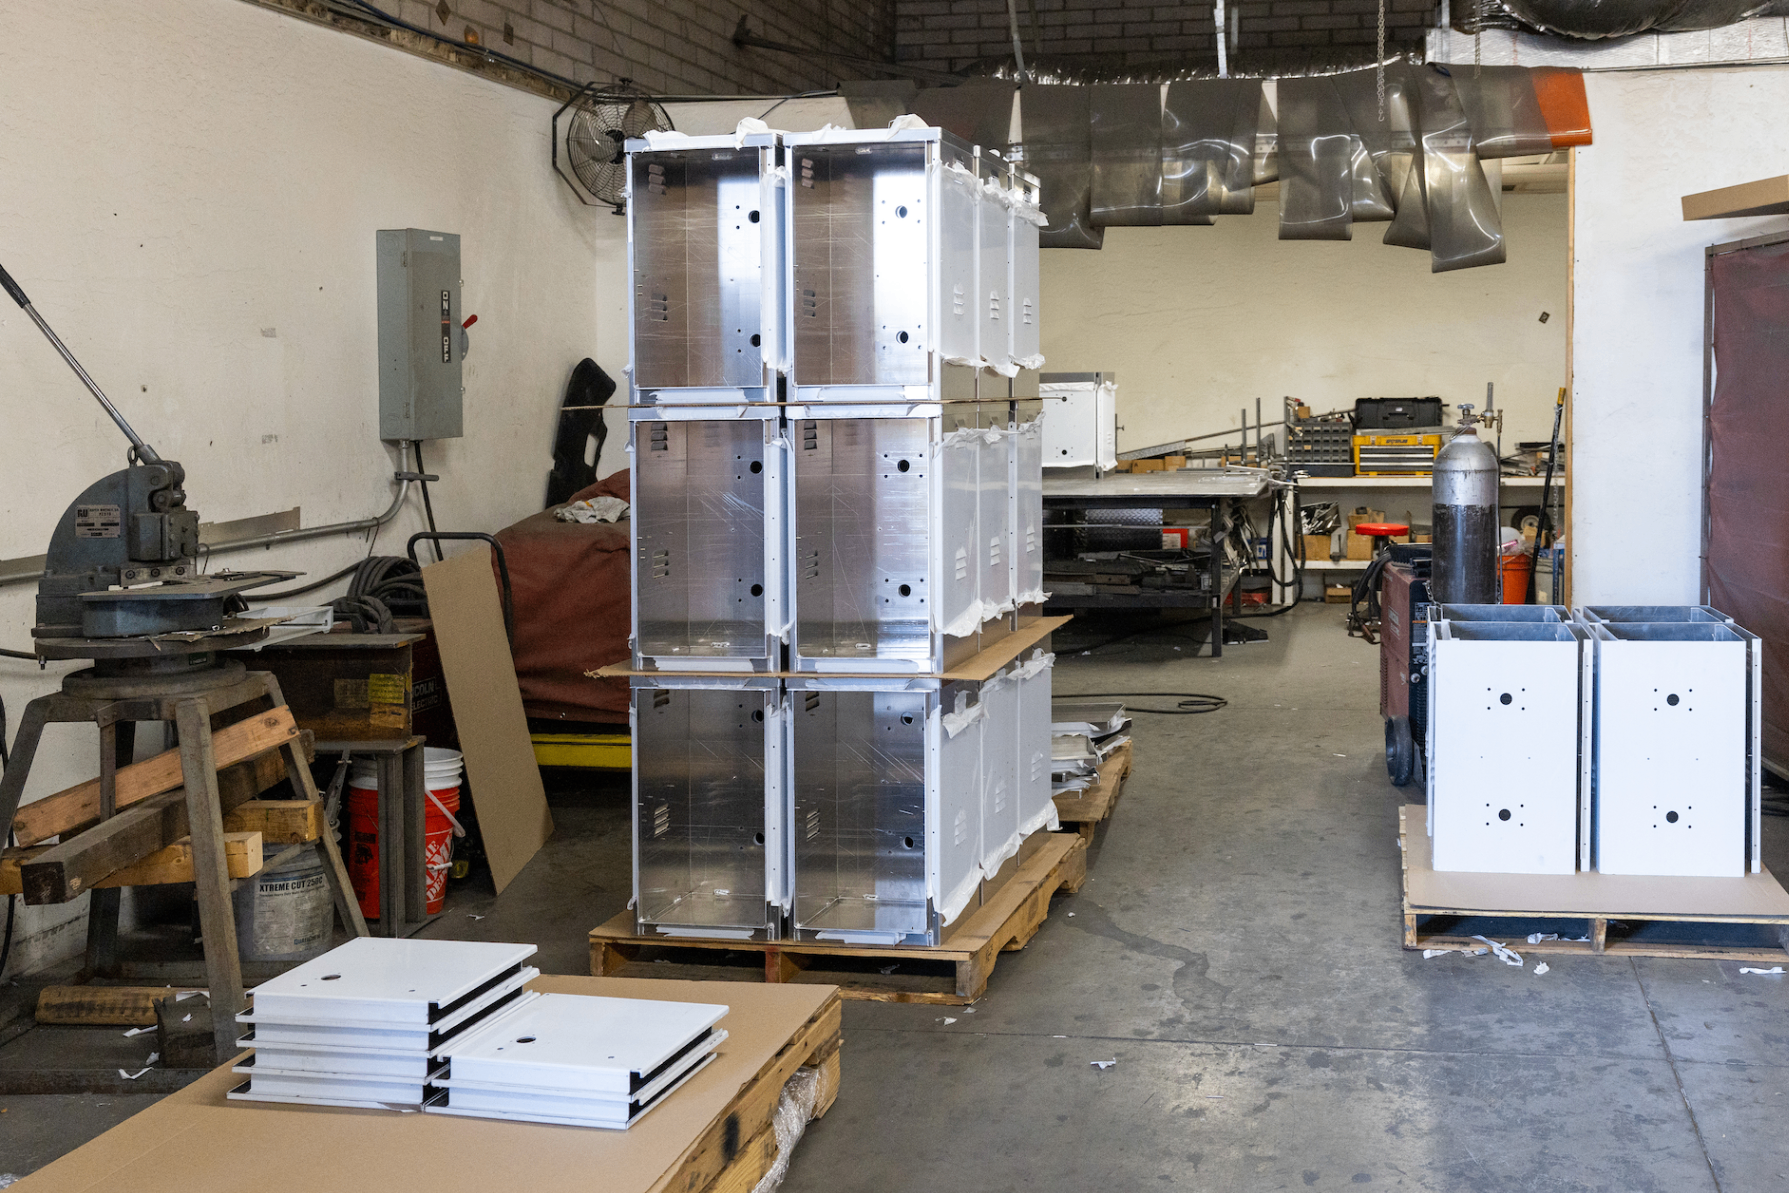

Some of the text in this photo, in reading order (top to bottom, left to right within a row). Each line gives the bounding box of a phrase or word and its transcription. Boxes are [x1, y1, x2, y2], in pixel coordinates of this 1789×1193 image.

[442, 291, 448, 310] ON
[412, 680, 435, 698] COLN
[259, 882, 290, 893] XTREME
[291, 880, 306, 890] CUT
